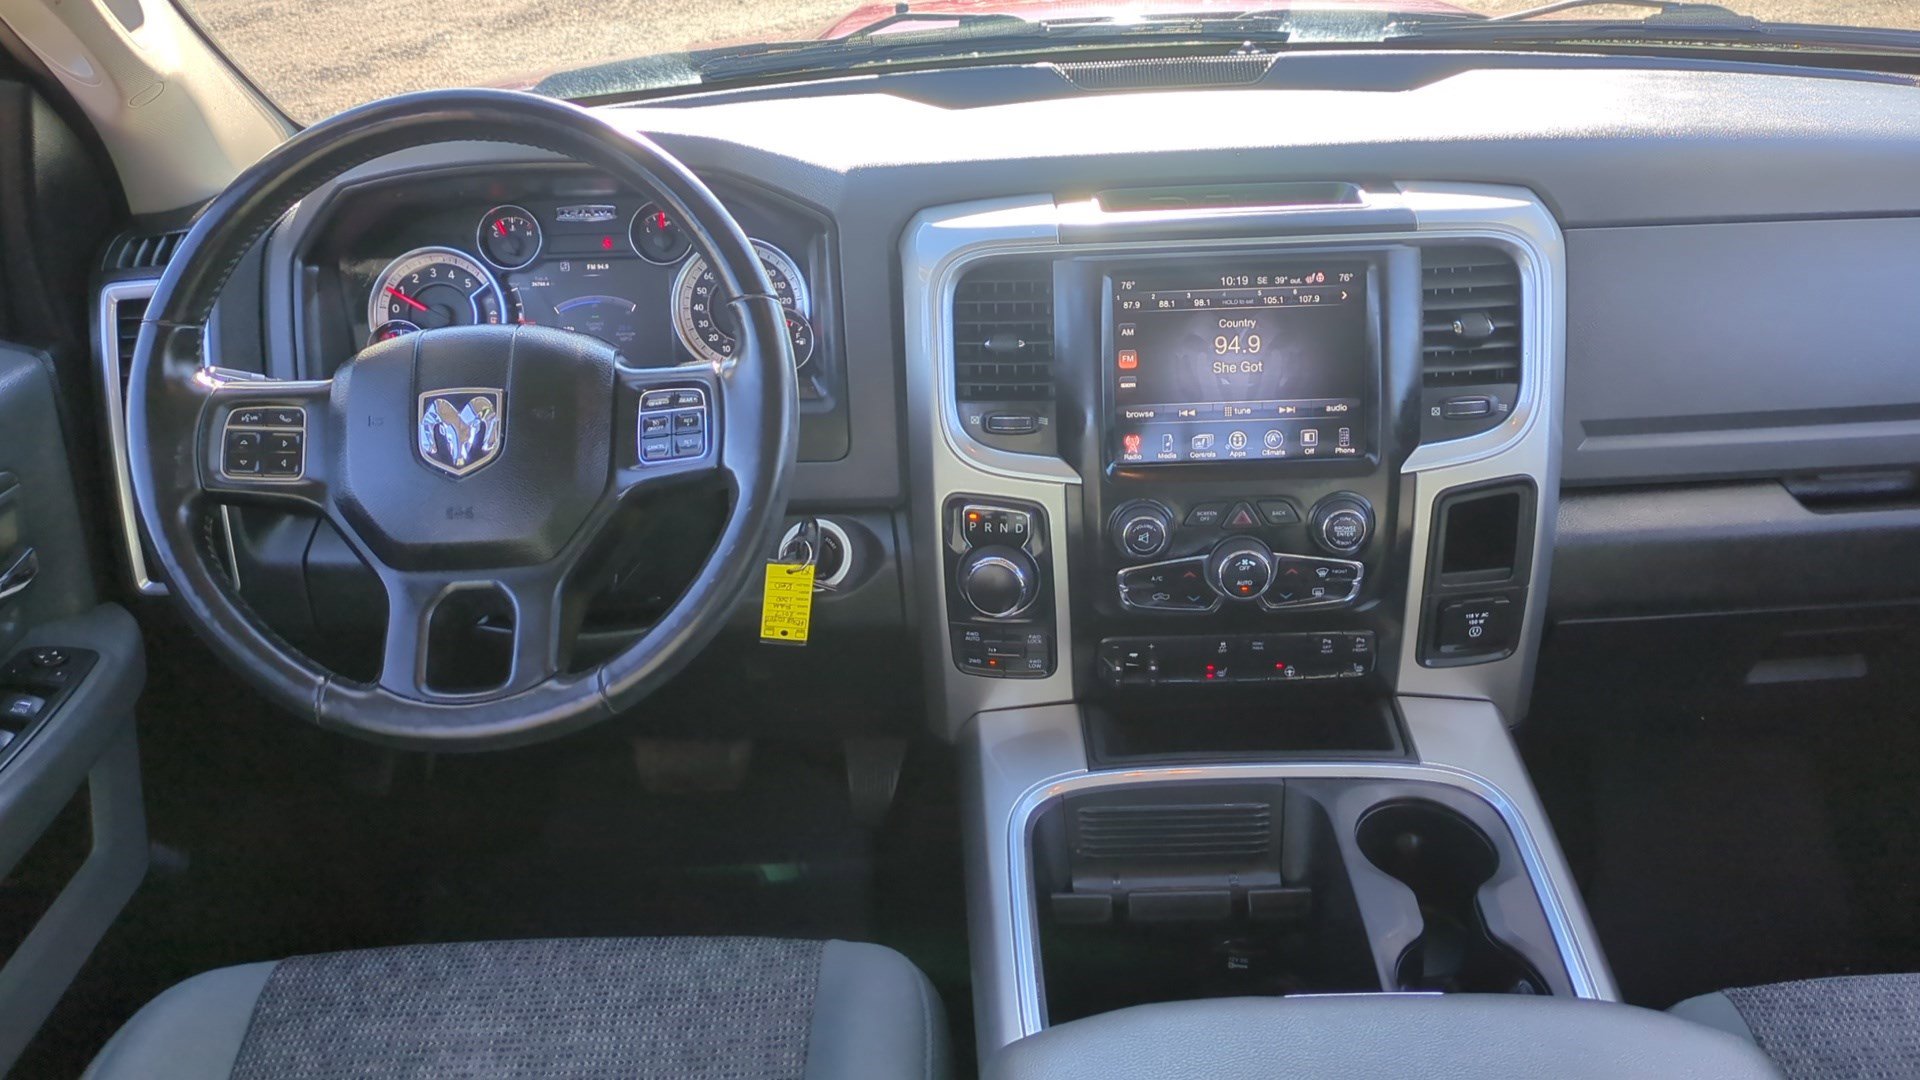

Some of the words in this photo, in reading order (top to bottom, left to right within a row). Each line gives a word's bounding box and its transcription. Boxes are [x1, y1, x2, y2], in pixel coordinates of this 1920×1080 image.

[430, 268, 437, 277] 3
[448, 270, 455, 279] 4
[412, 274, 420, 284] 2
[465, 278, 471, 288] 5
[1220, 276, 1248, 286] 10:19
[1256, 276, 1268, 285] SE
[1194, 298, 1210, 307] 98.1
[1263, 296, 1284, 304] 105.1
[1299, 294, 1320, 303] 107.9
[392, 304, 400, 313] 0
[1123, 301, 1140, 309] 87.9
[1158, 300, 1175, 308] 88.1
[1219, 318, 1256, 329] Country
[1214, 334, 1261, 354] 94.9
[1122, 355, 1134, 363] FM
[1213, 362, 1237, 373] She
[1240, 361, 1262, 373] Got
[1326, 404, 1348, 412] audio
[1126, 410, 1154, 418] browse
[1262, 448, 1285, 456] Climate
[969, 522, 976, 531] P
[984, 523, 992, 532] R
[1000, 523, 1008, 533] N
[1015, 524, 1023, 533] D
